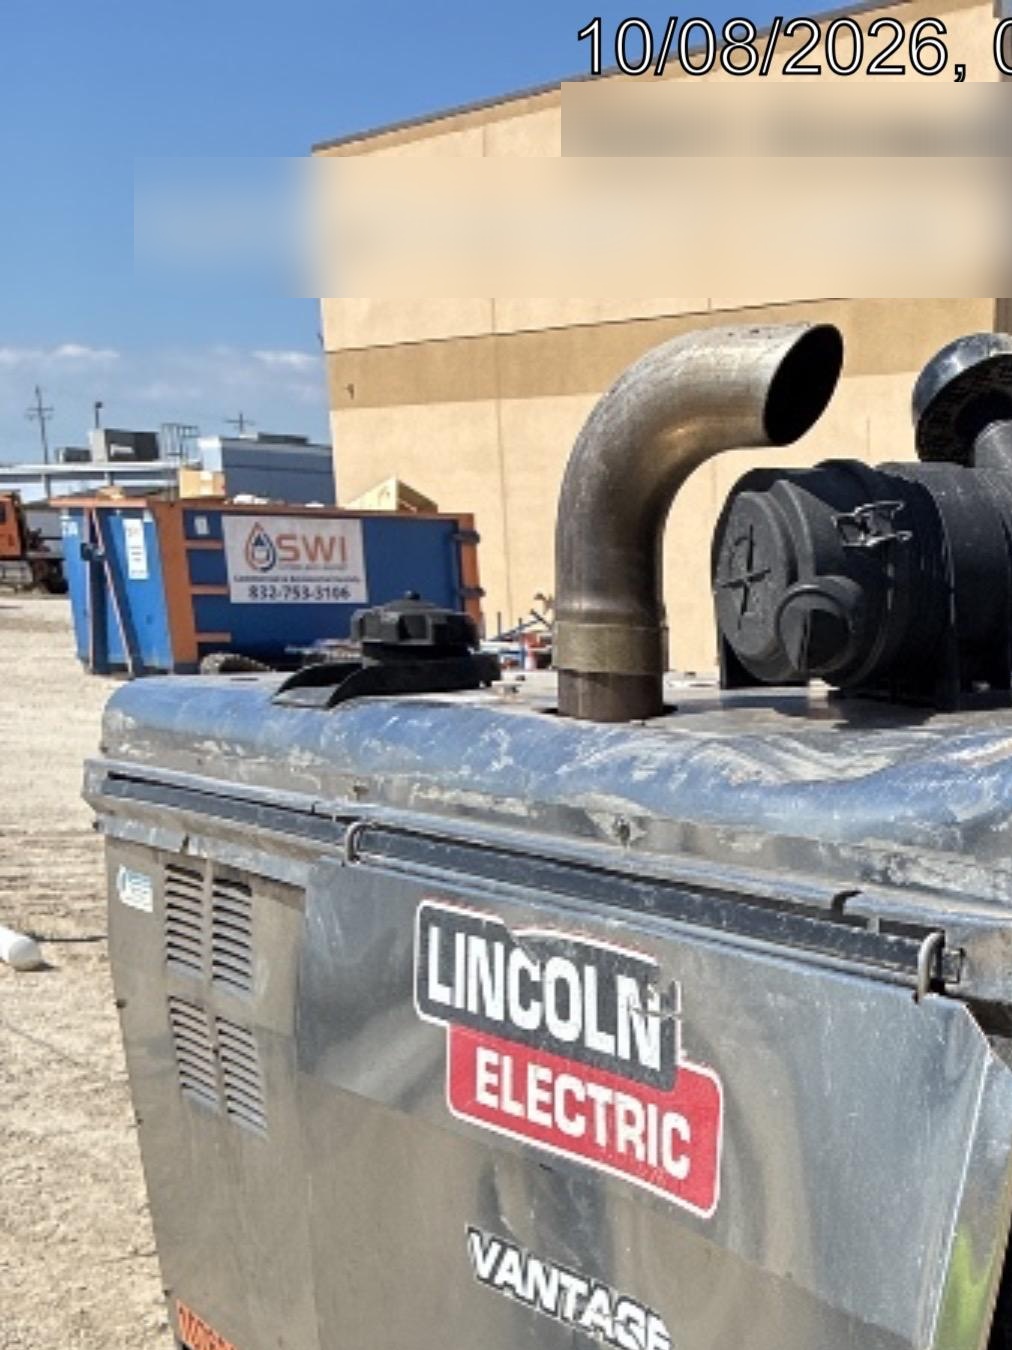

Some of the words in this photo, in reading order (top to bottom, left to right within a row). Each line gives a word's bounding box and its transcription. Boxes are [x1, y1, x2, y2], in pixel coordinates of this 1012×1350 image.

[275, 533, 347, 563] SWI
[428, 925, 661, 1073] LINCOLN
[475, 1046, 691, 1181] ELECTRIC
